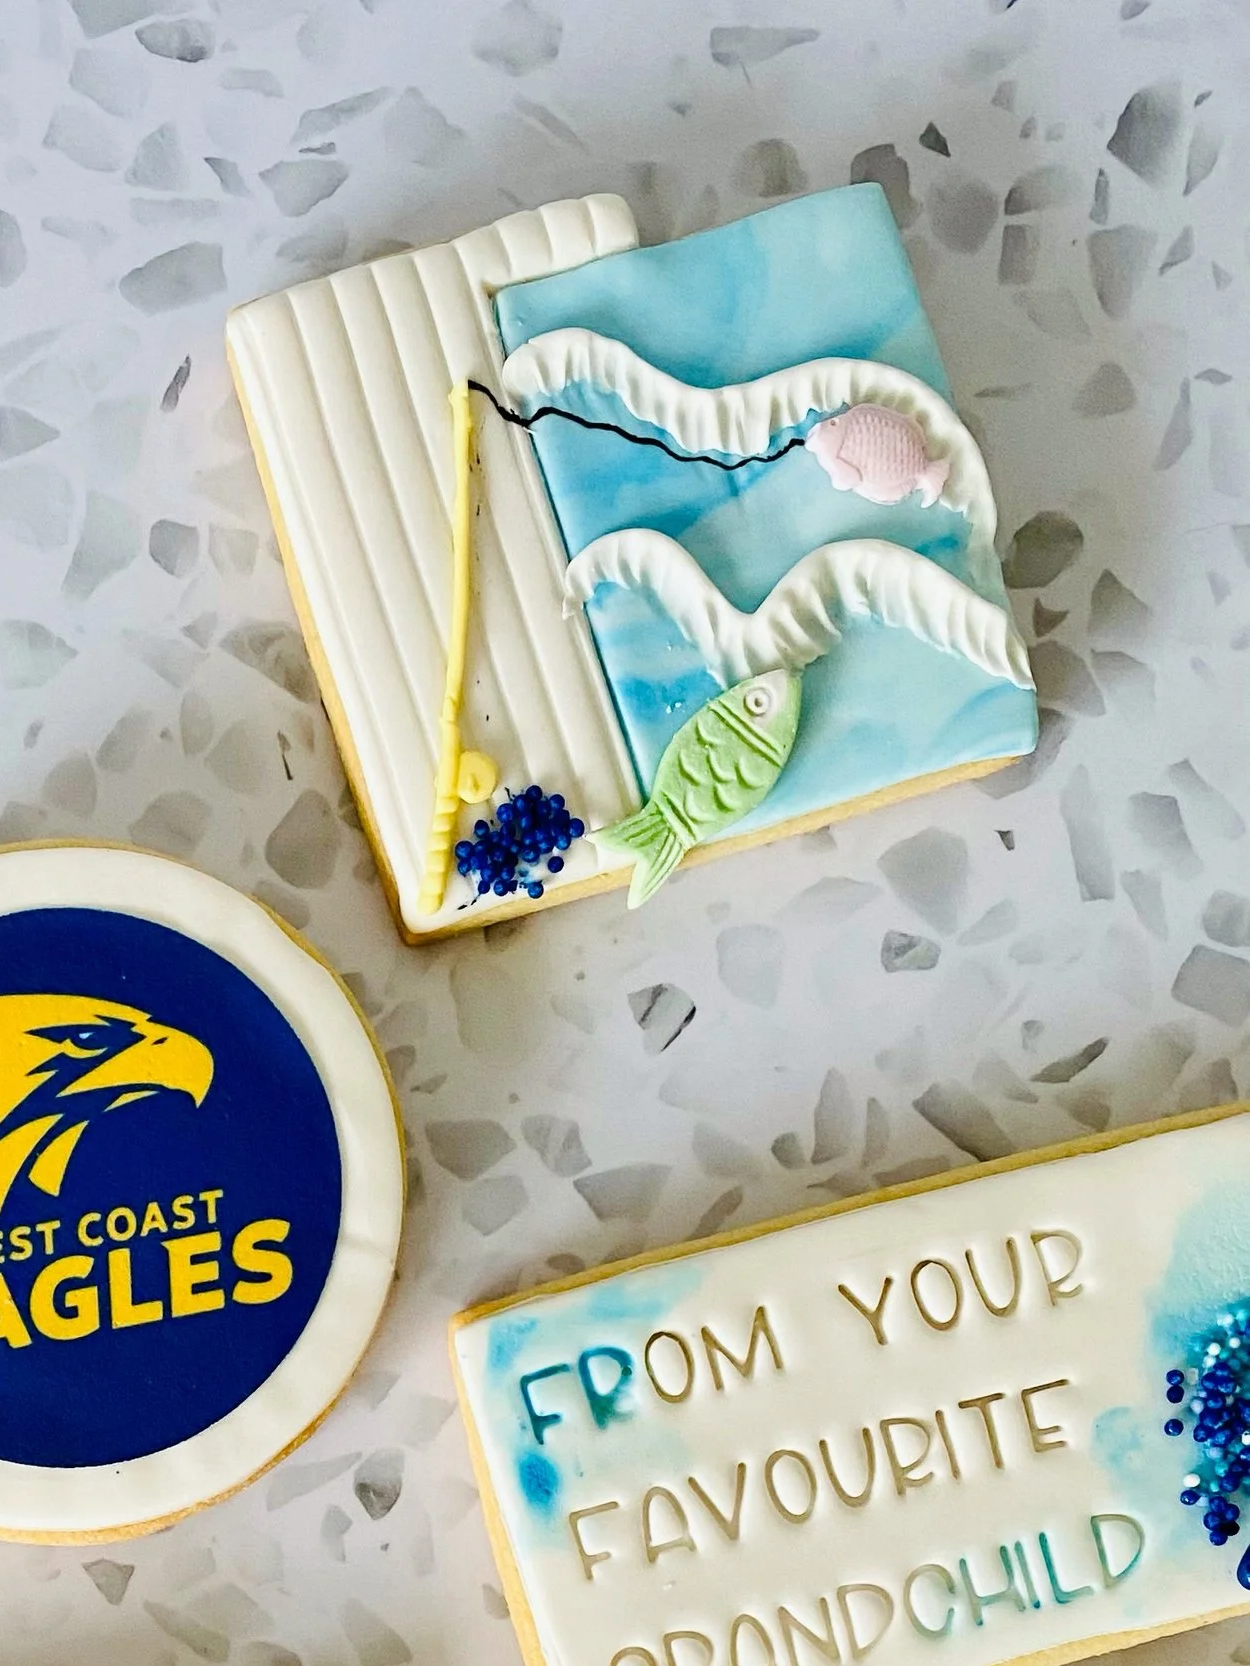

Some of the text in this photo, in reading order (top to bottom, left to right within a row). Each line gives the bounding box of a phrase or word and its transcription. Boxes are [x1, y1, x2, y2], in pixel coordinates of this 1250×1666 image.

[77, 1189, 224, 1247] COAST
[520, 1229, 1085, 1445] FROM YOUR
[568, 1379, 1071, 1581] FAVOURITE
